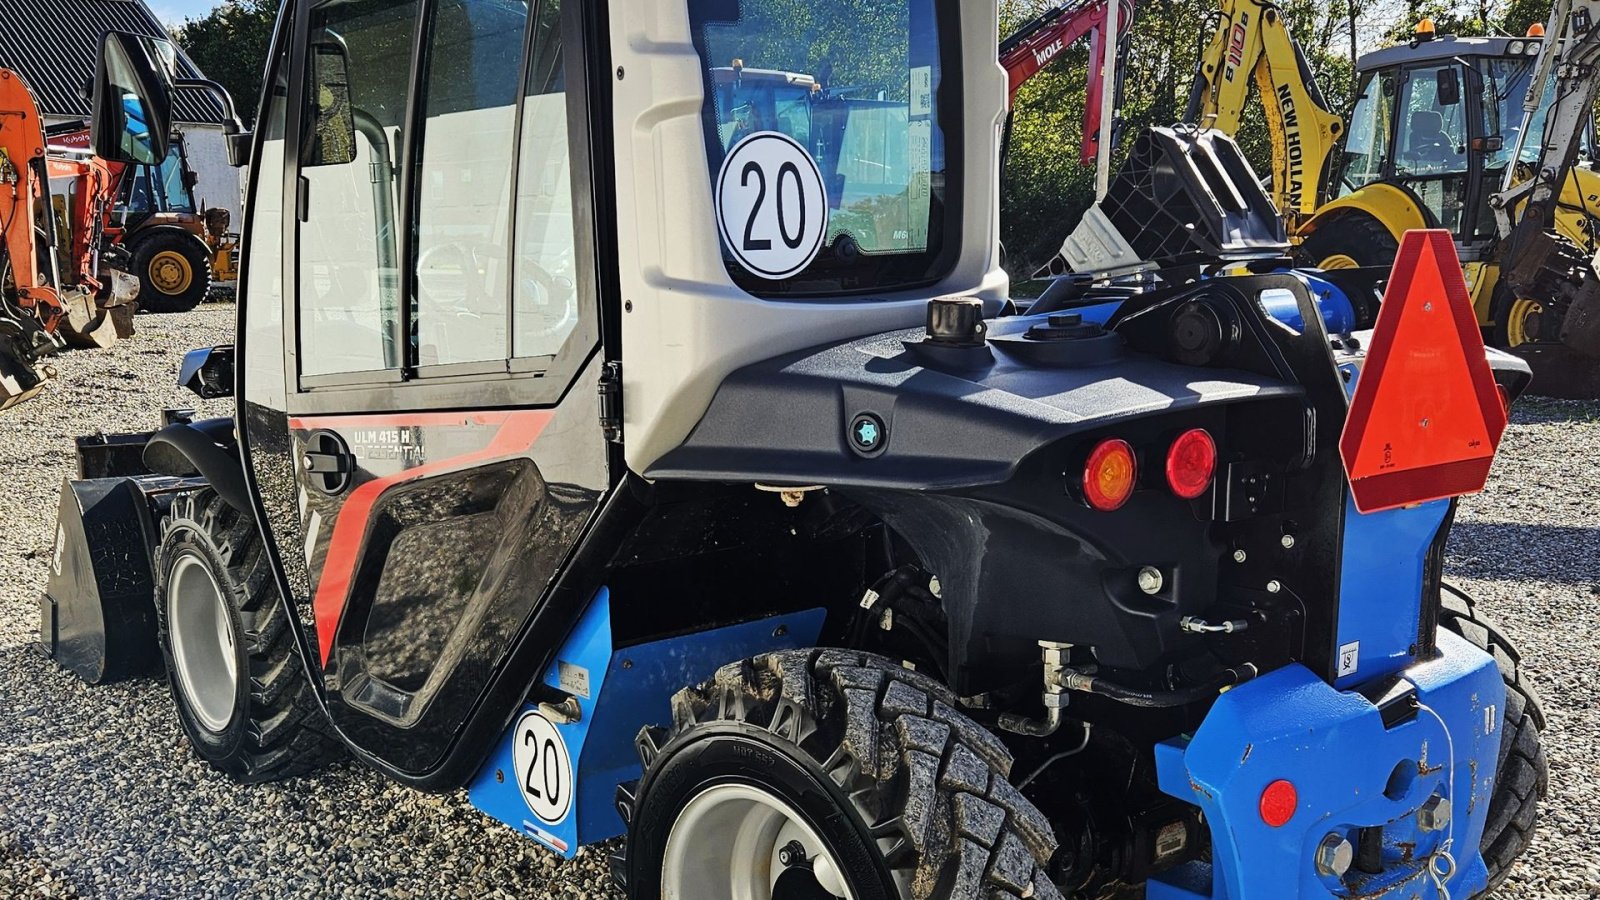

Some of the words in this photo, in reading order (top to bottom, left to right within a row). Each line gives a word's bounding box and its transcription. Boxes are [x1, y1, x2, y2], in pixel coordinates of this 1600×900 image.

[1228, 22, 1246, 67] 110
[1225, 66, 1234, 83] B
[1277, 82, 1298, 128] NEW
[62, 134, 90, 144] Kubota
[741, 160, 806, 251] 20
[354, 431, 377, 444] ULM
[378, 430, 399, 444] 415
[401, 429, 410, 444] H
[524, 728, 560, 807] 20
